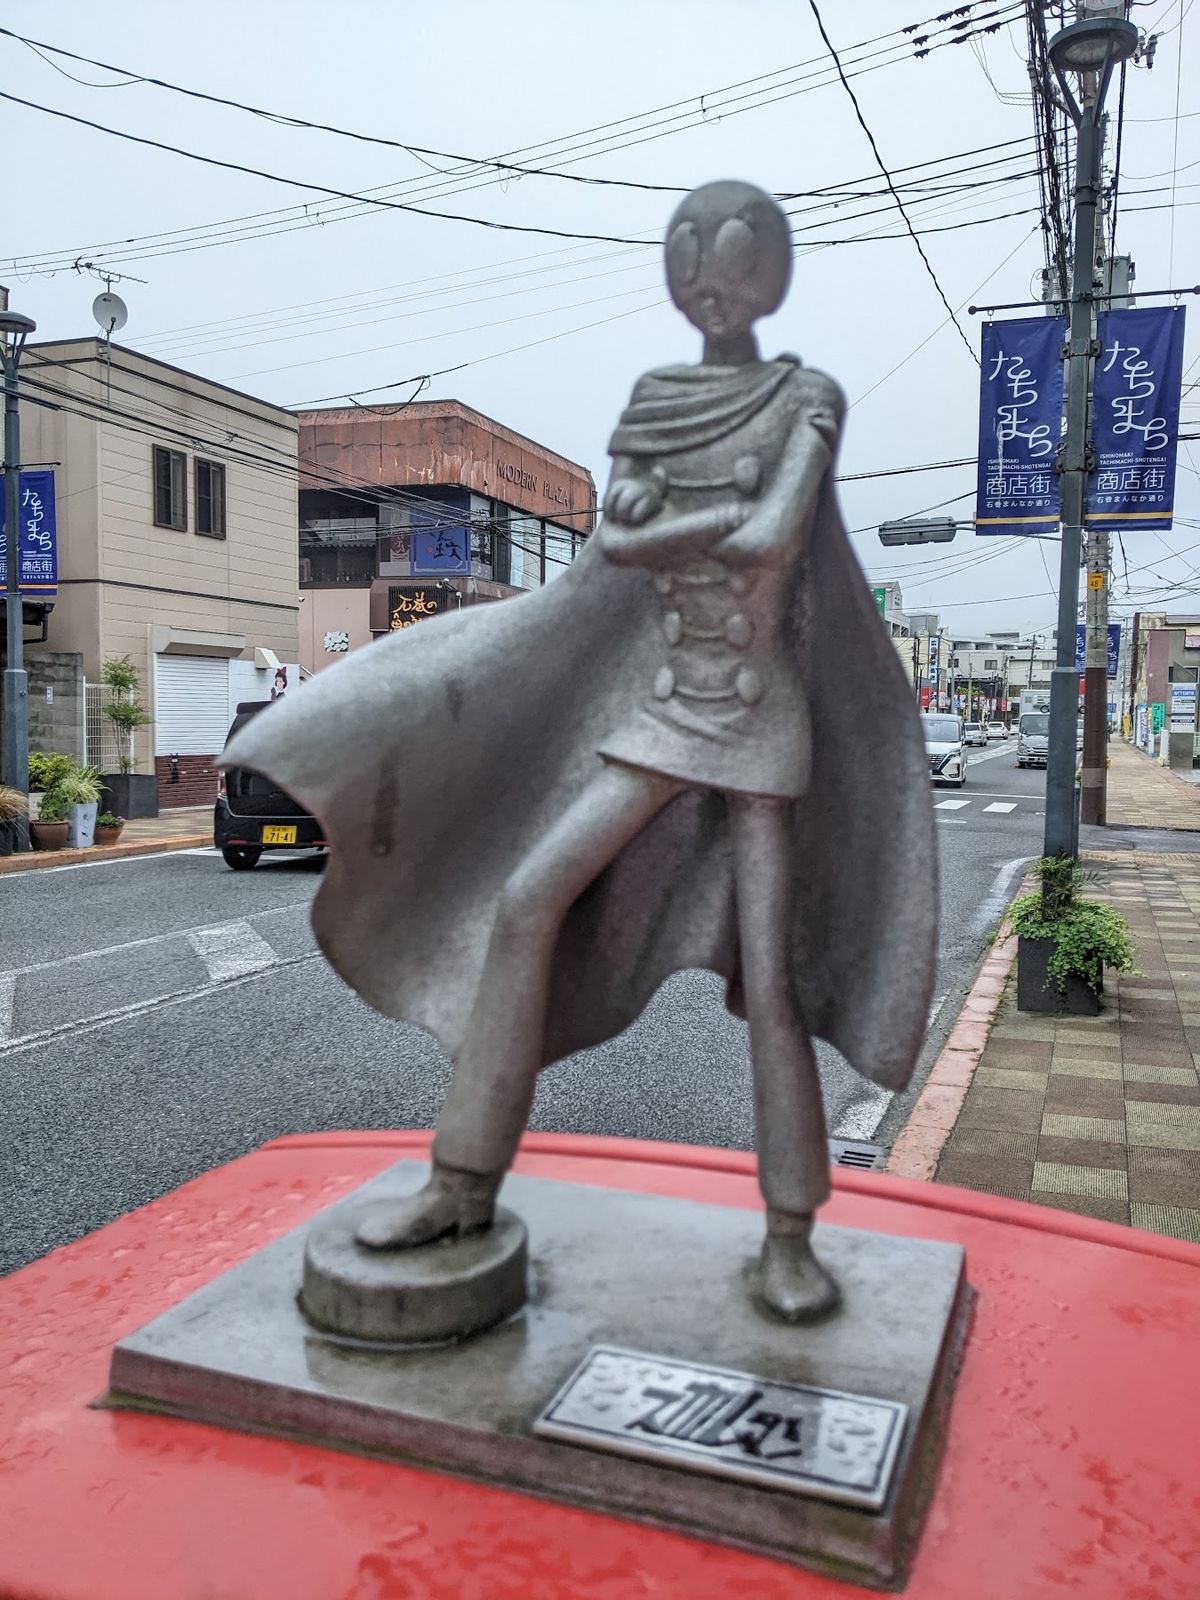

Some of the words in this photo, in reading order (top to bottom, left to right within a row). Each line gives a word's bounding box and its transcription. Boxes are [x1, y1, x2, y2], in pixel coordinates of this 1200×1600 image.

[988, 350, 1053, 458] たちまち
[1103, 340, 1169, 451] たちまち
[1099, 456, 1167, 465] TACHIMACHI-SHOTENGAI
[496, 458, 538, 492] MODERN
[543, 480, 569, 508] PLAZA
[986, 473, 1052, 496] 商店街
[1097, 468, 1166, 491] 商店街
[1096, 494, 1164, 504] 石巻まんなか通り
[22, 488, 53, 551] たちまち
[22, 560, 53, 572] 商店街
[270, 832, 293, 842] 71-41
